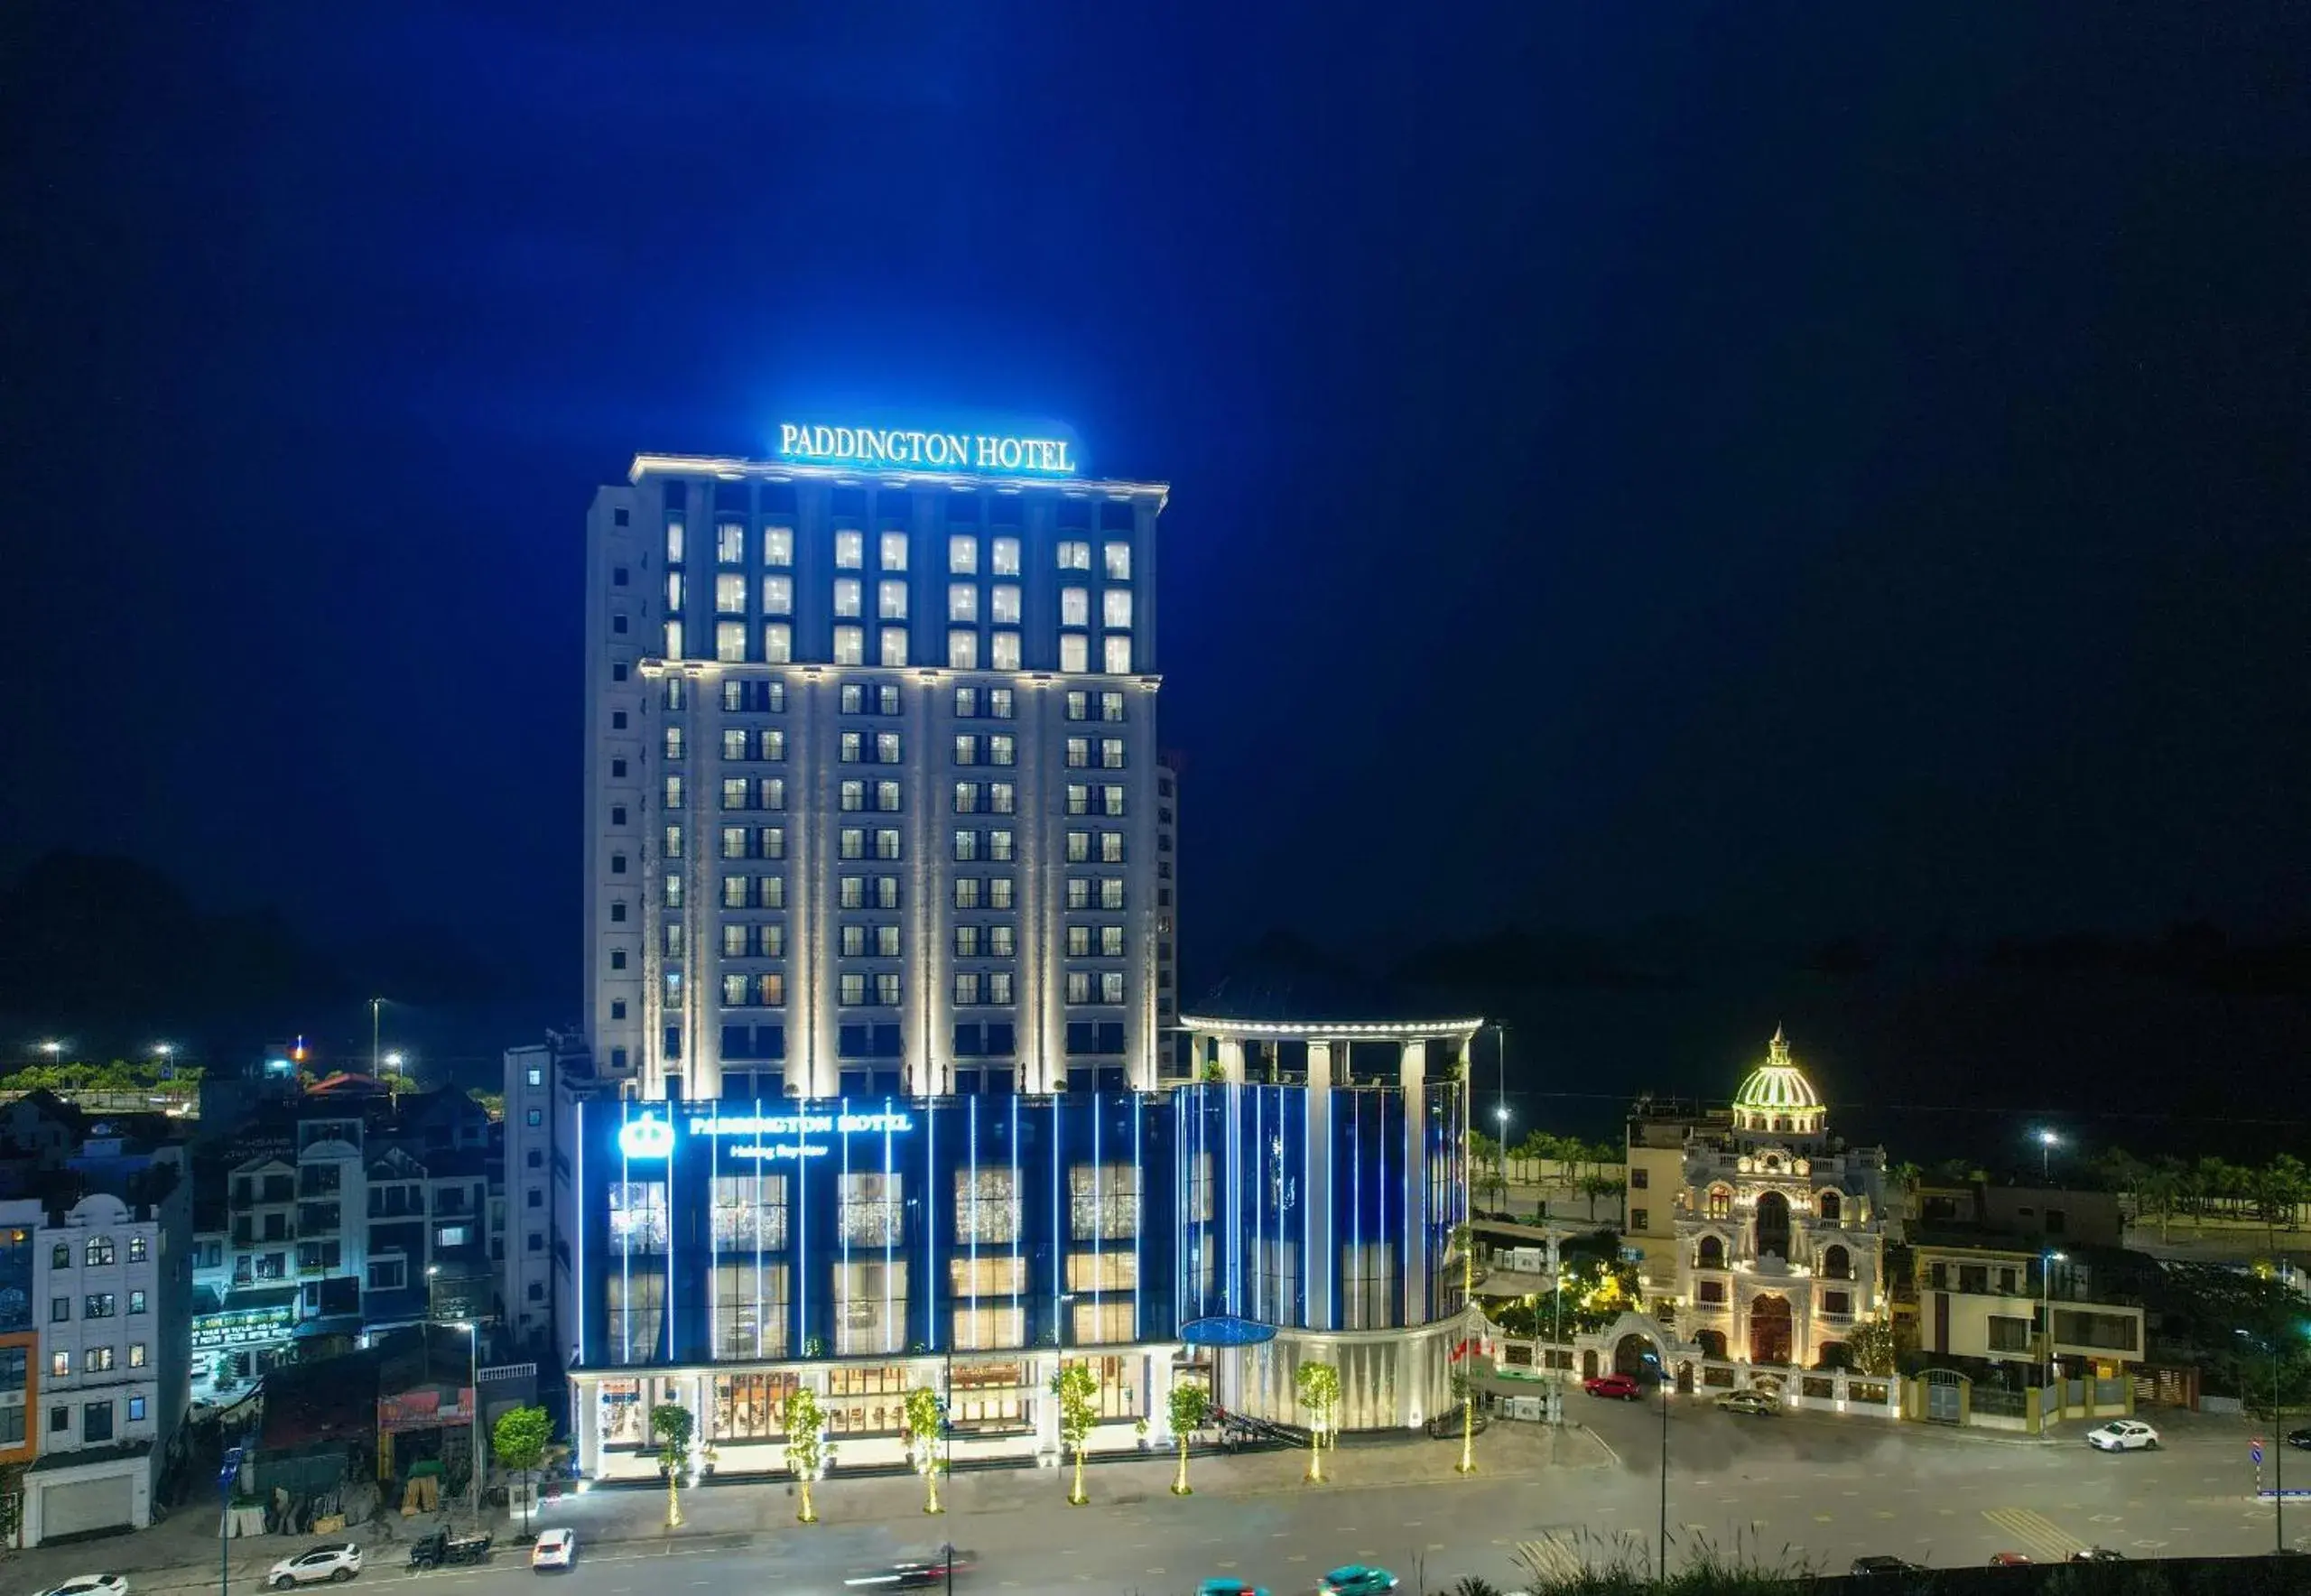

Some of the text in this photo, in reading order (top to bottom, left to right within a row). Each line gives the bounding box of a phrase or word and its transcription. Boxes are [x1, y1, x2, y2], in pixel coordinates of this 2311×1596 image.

[780, 423, 1075, 472] PADDINGTON HOTEL
[690, 1114, 914, 1135] PADDINGTON HOTEL
